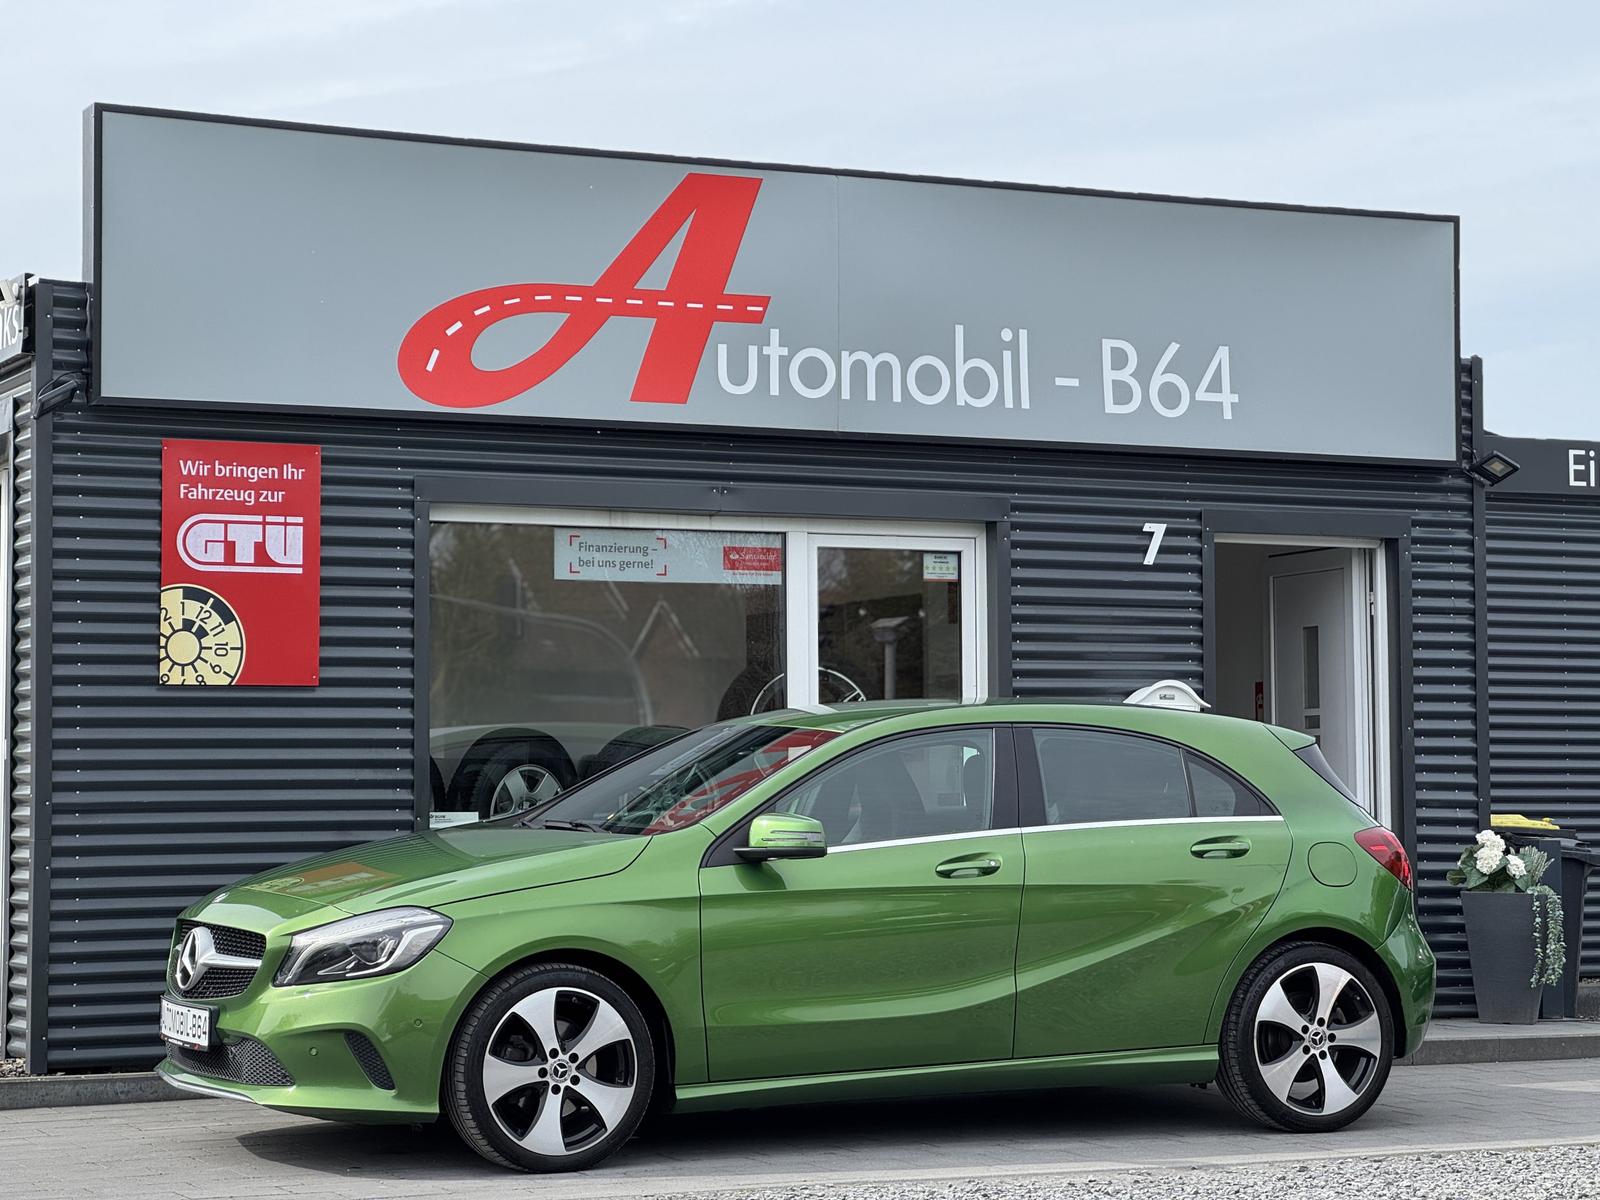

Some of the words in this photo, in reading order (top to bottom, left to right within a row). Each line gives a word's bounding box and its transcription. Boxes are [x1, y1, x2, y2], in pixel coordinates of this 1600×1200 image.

[397, 172, 1030, 410] Automobil
[1101, 338, 1239, 419] B64
[178, 459, 212, 477] Wir
[214, 460, 279, 483] bringen
[283, 463, 305, 480] Ihr
[178, 483, 255, 506] Fahrzeug
[258, 489, 286, 503] zur
[184, 514, 304, 566] GTÜ
[578, 541, 650, 557] Finanzierung
[1142, 522, 1168, 566] 7
[578, 556, 596, 568] bei
[597, 559, 617, 569] uns
[619, 559, 654, 572] gerne!
[180, 601, 185, 616] 1
[195, 605, 213, 625] 12
[209, 621, 226, 637] 11
[214, 641, 229, 657] 10
